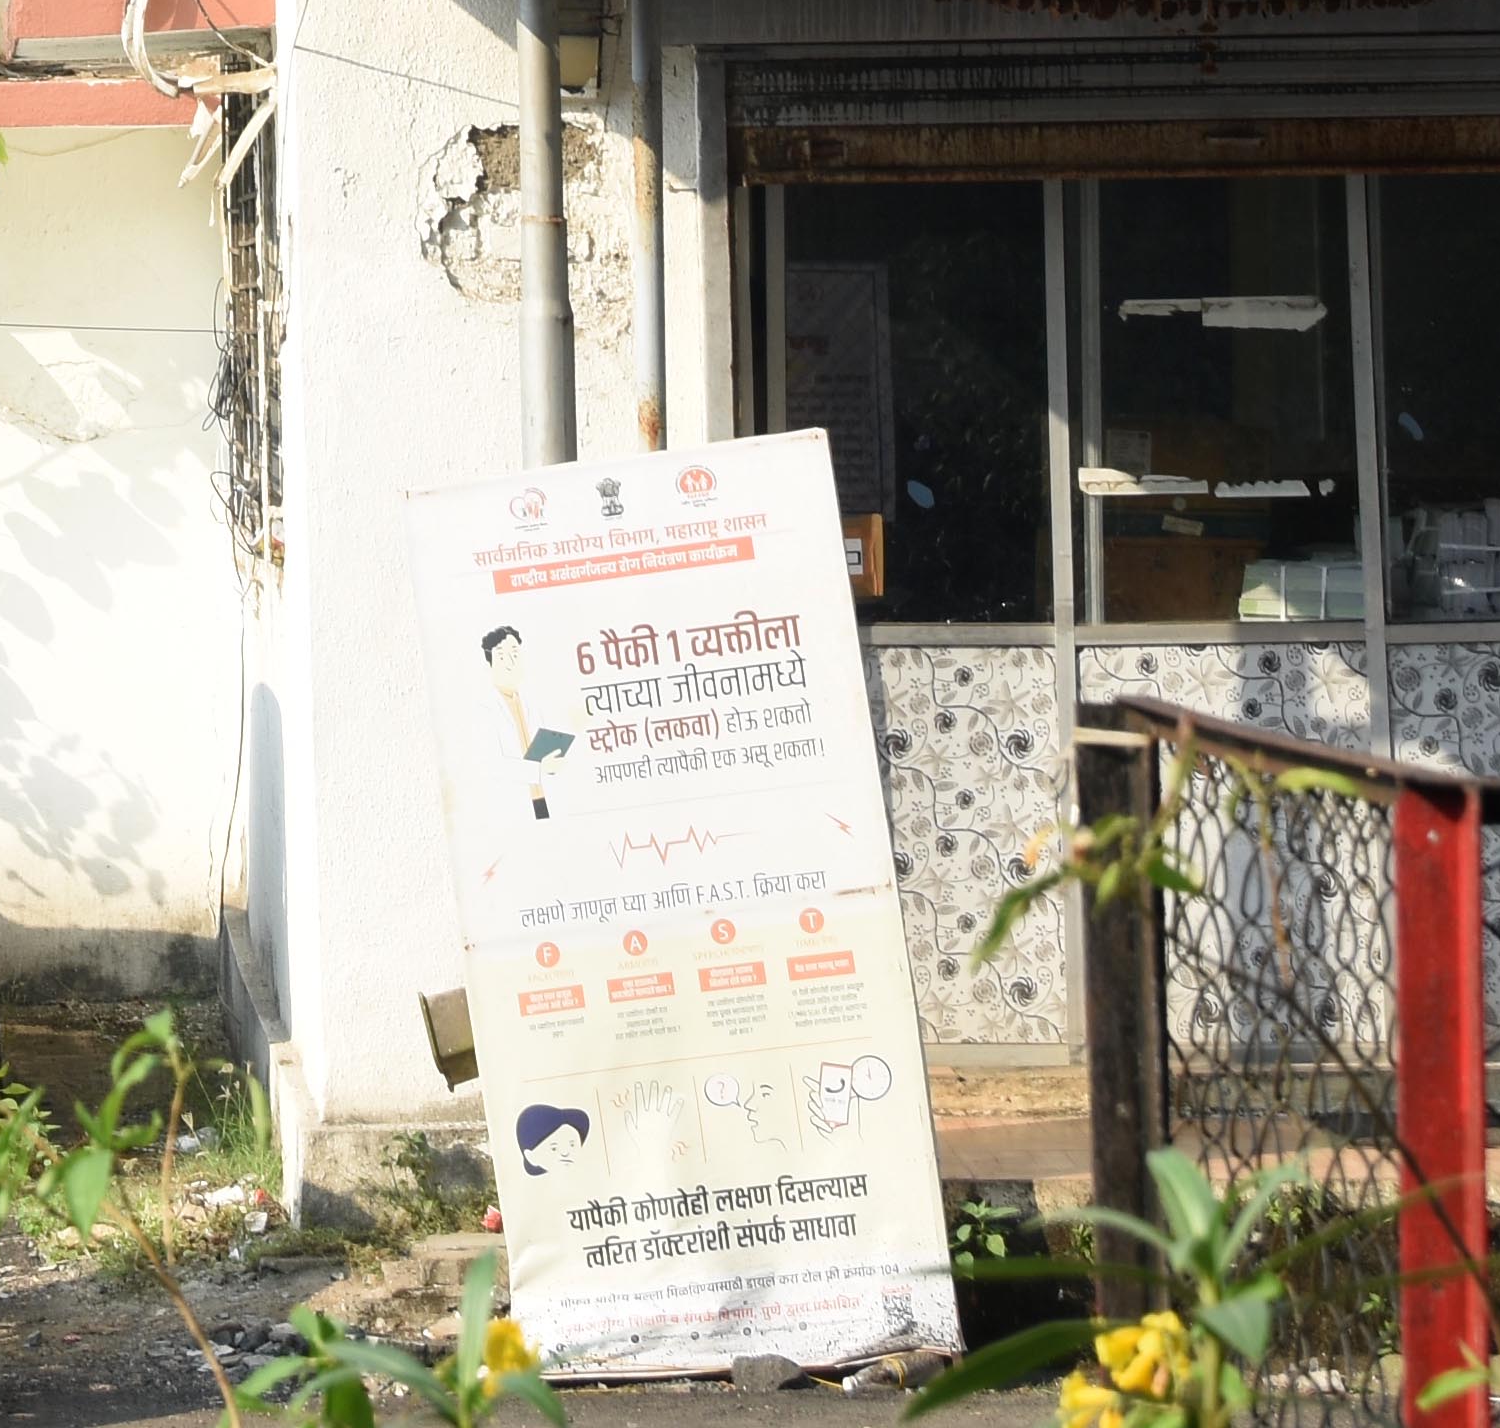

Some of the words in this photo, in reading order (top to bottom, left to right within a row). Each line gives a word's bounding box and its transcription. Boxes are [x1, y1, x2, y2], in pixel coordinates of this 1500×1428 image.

[472, 541, 548, 567] सार्वजनिक
[553, 533, 604, 555] आरोग्य
[609, 528, 660, 548] विभाग,
[664, 520, 718, 539] महाराष्ट्र
[724, 514, 767, 533] शासन
[618, 556, 640, 572] रोग
[642, 551, 687, 569] नियंत्रण
[688, 542, 738, 562] कार्यक्रम
[576, 641, 596, 675] 6
[599, 624, 659, 670] पैकी
[667, 630, 681, 662] 1
[686, 610, 801, 657] व्यक्तीला
[581, 678, 662, 716] त्याच्या
[667, 650, 806, 704] जीवनामध्ये
[587, 720, 638, 753] स्ट्रोक
[645, 708, 719, 748] (लकवा)
[724, 707, 758, 733] होऊ
[763, 697, 812, 728] शकतो
[595, 755, 652, 784] आपणही
[656, 748, 708, 777] त्यापैकी
[712, 749, 736, 770] एक
[741, 744, 774, 767] असू
[520, 900, 566, 927] लक्षणे
[570, 898, 617, 923] जाणून
[622, 893, 647, 914] घ्या
[652, 882, 691, 910] आणि
[696, 880, 750, 905] F.A.S.T.
[753, 873, 791, 898] क्रिया
[796, 870, 826, 890] करा
[805, 912, 817, 929] T
[630, 935, 642, 951] A
[717, 923, 729, 940] S
[542, 947, 553, 963] F
[567, 1196, 628, 1232] यापैकी
[632, 1185, 709, 1222] कोणतेही
[712, 1184, 772, 1213] लक्षण
[777, 1174, 868, 1205] दिसल्यास
[583, 1236, 637, 1268] त्वरित
[640, 1221, 731, 1262] डॉक्टरांशी
[734, 1216, 786, 1248] संपर्क
[789, 1213, 857, 1241] साधावा
[746, 1276, 775, 1290] डायल
[779, 1274, 798, 1285] करा
[801, 1269, 822, 1284] टोल
[879, 1264, 899, 1277] 104
